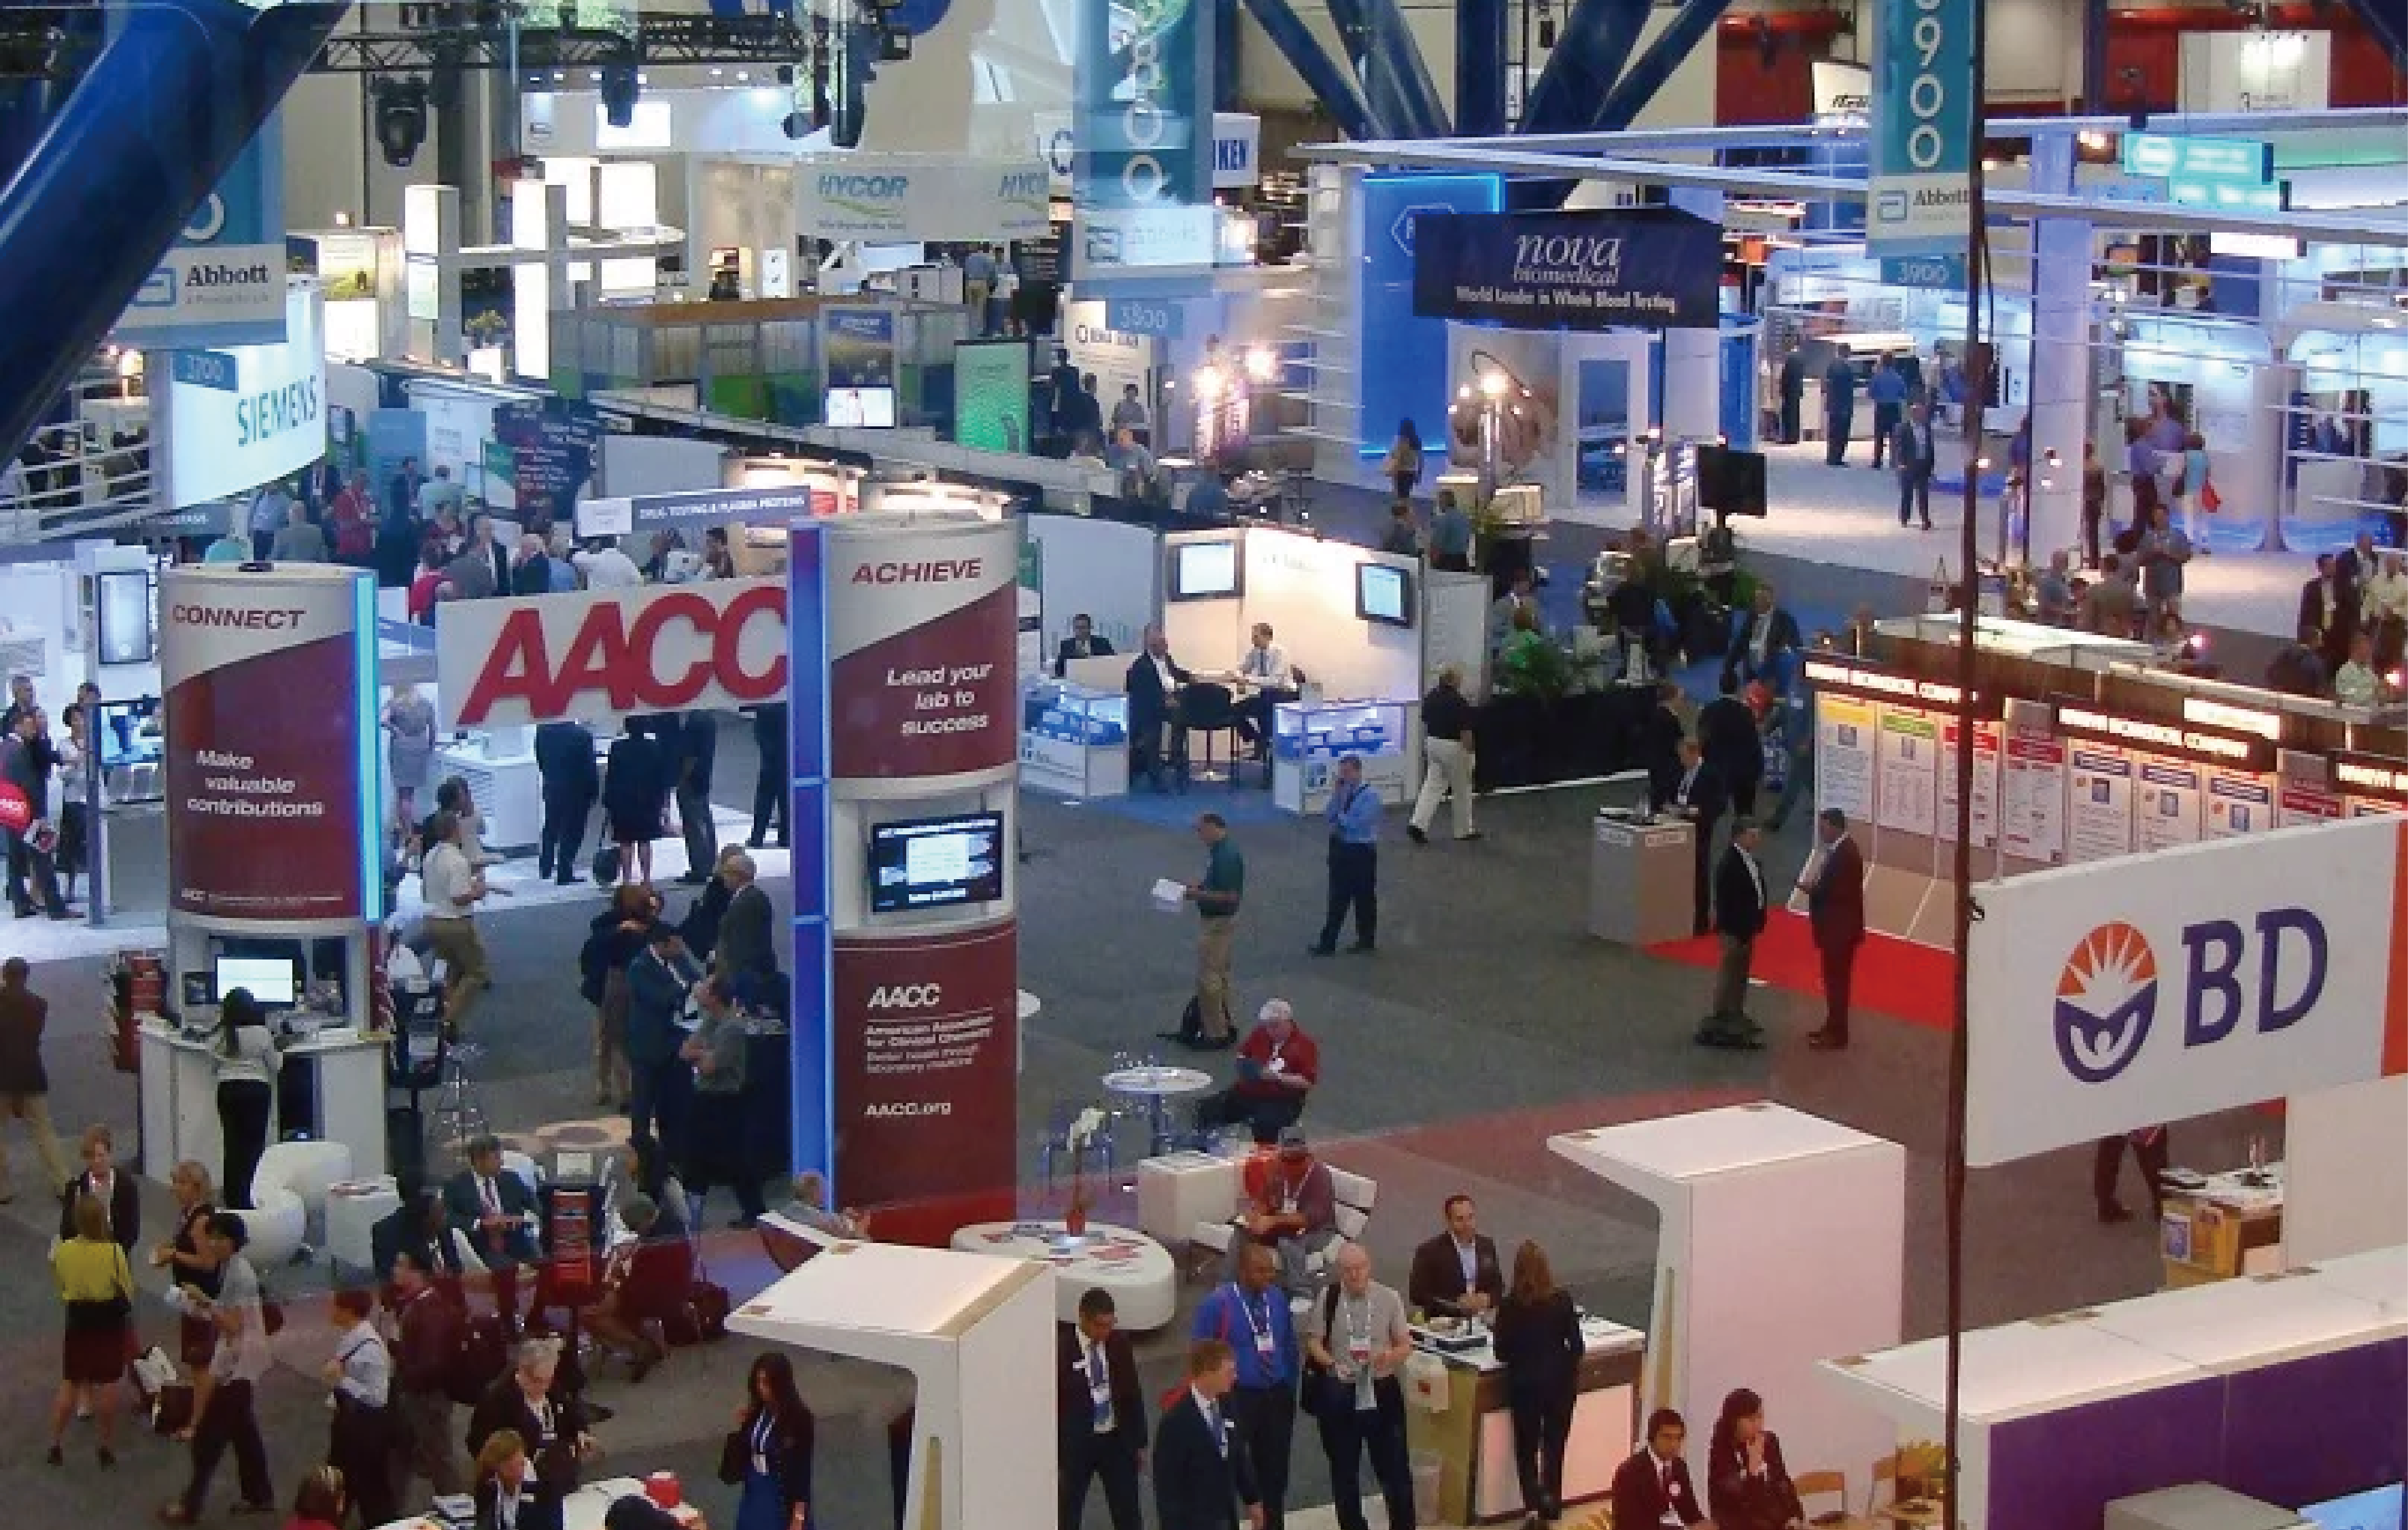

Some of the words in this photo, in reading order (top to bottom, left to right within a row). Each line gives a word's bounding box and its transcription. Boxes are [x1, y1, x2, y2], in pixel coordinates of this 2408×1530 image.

[1908, 0, 1944, 168] 900
[819, 174, 908, 197] HYCOR
[1515, 235, 1623, 267] nova
[185, 265, 269, 287] Abbott
[1456, 286, 1493, 303] World
[1633, 293, 1676, 314] Testing
[237, 375, 317, 446] SIEMENS
[852, 558, 983, 585] ACHIEVE
[171, 604, 306, 630] CONNECT
[456, 585, 787, 726] AACC
[886, 665, 946, 685] Lead
[949, 662, 994, 687] your
[914, 691, 950, 710] lab
[954, 689, 976, 707] to
[901, 712, 990, 737] success
[195, 749, 254, 770] Make
[205, 776, 296, 794] valuable
[186, 797, 326, 817] contributions
[2182, 908, 2328, 1047] BD
[867, 983, 941, 1008] AACC
[865, 1102, 952, 1117] AACC.org
